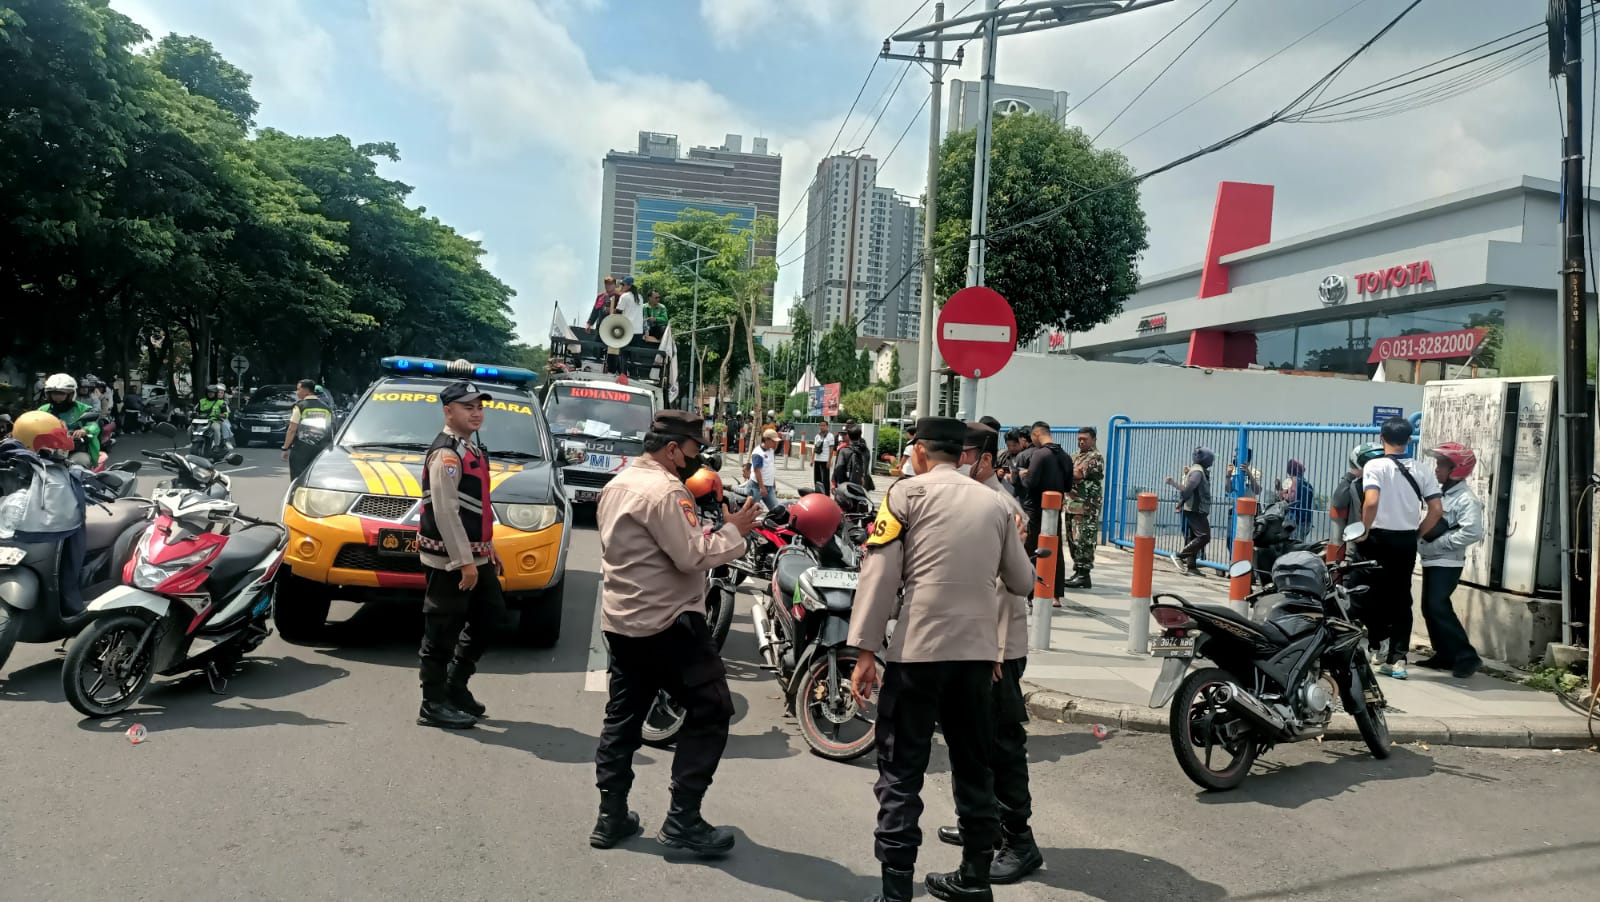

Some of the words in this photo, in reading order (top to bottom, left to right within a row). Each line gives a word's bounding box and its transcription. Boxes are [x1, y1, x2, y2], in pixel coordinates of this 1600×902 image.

[1354, 260, 1434, 294] TOYOTA
[1392, 333, 1474, 357] 031-8282000
[570, 387, 632, 402] KOMANDO
[372, 393, 438, 403] KORPS
[481, 400, 533, 415] HARA
[586, 442, 614, 452] UZU
[404, 539, 419, 553] 29
